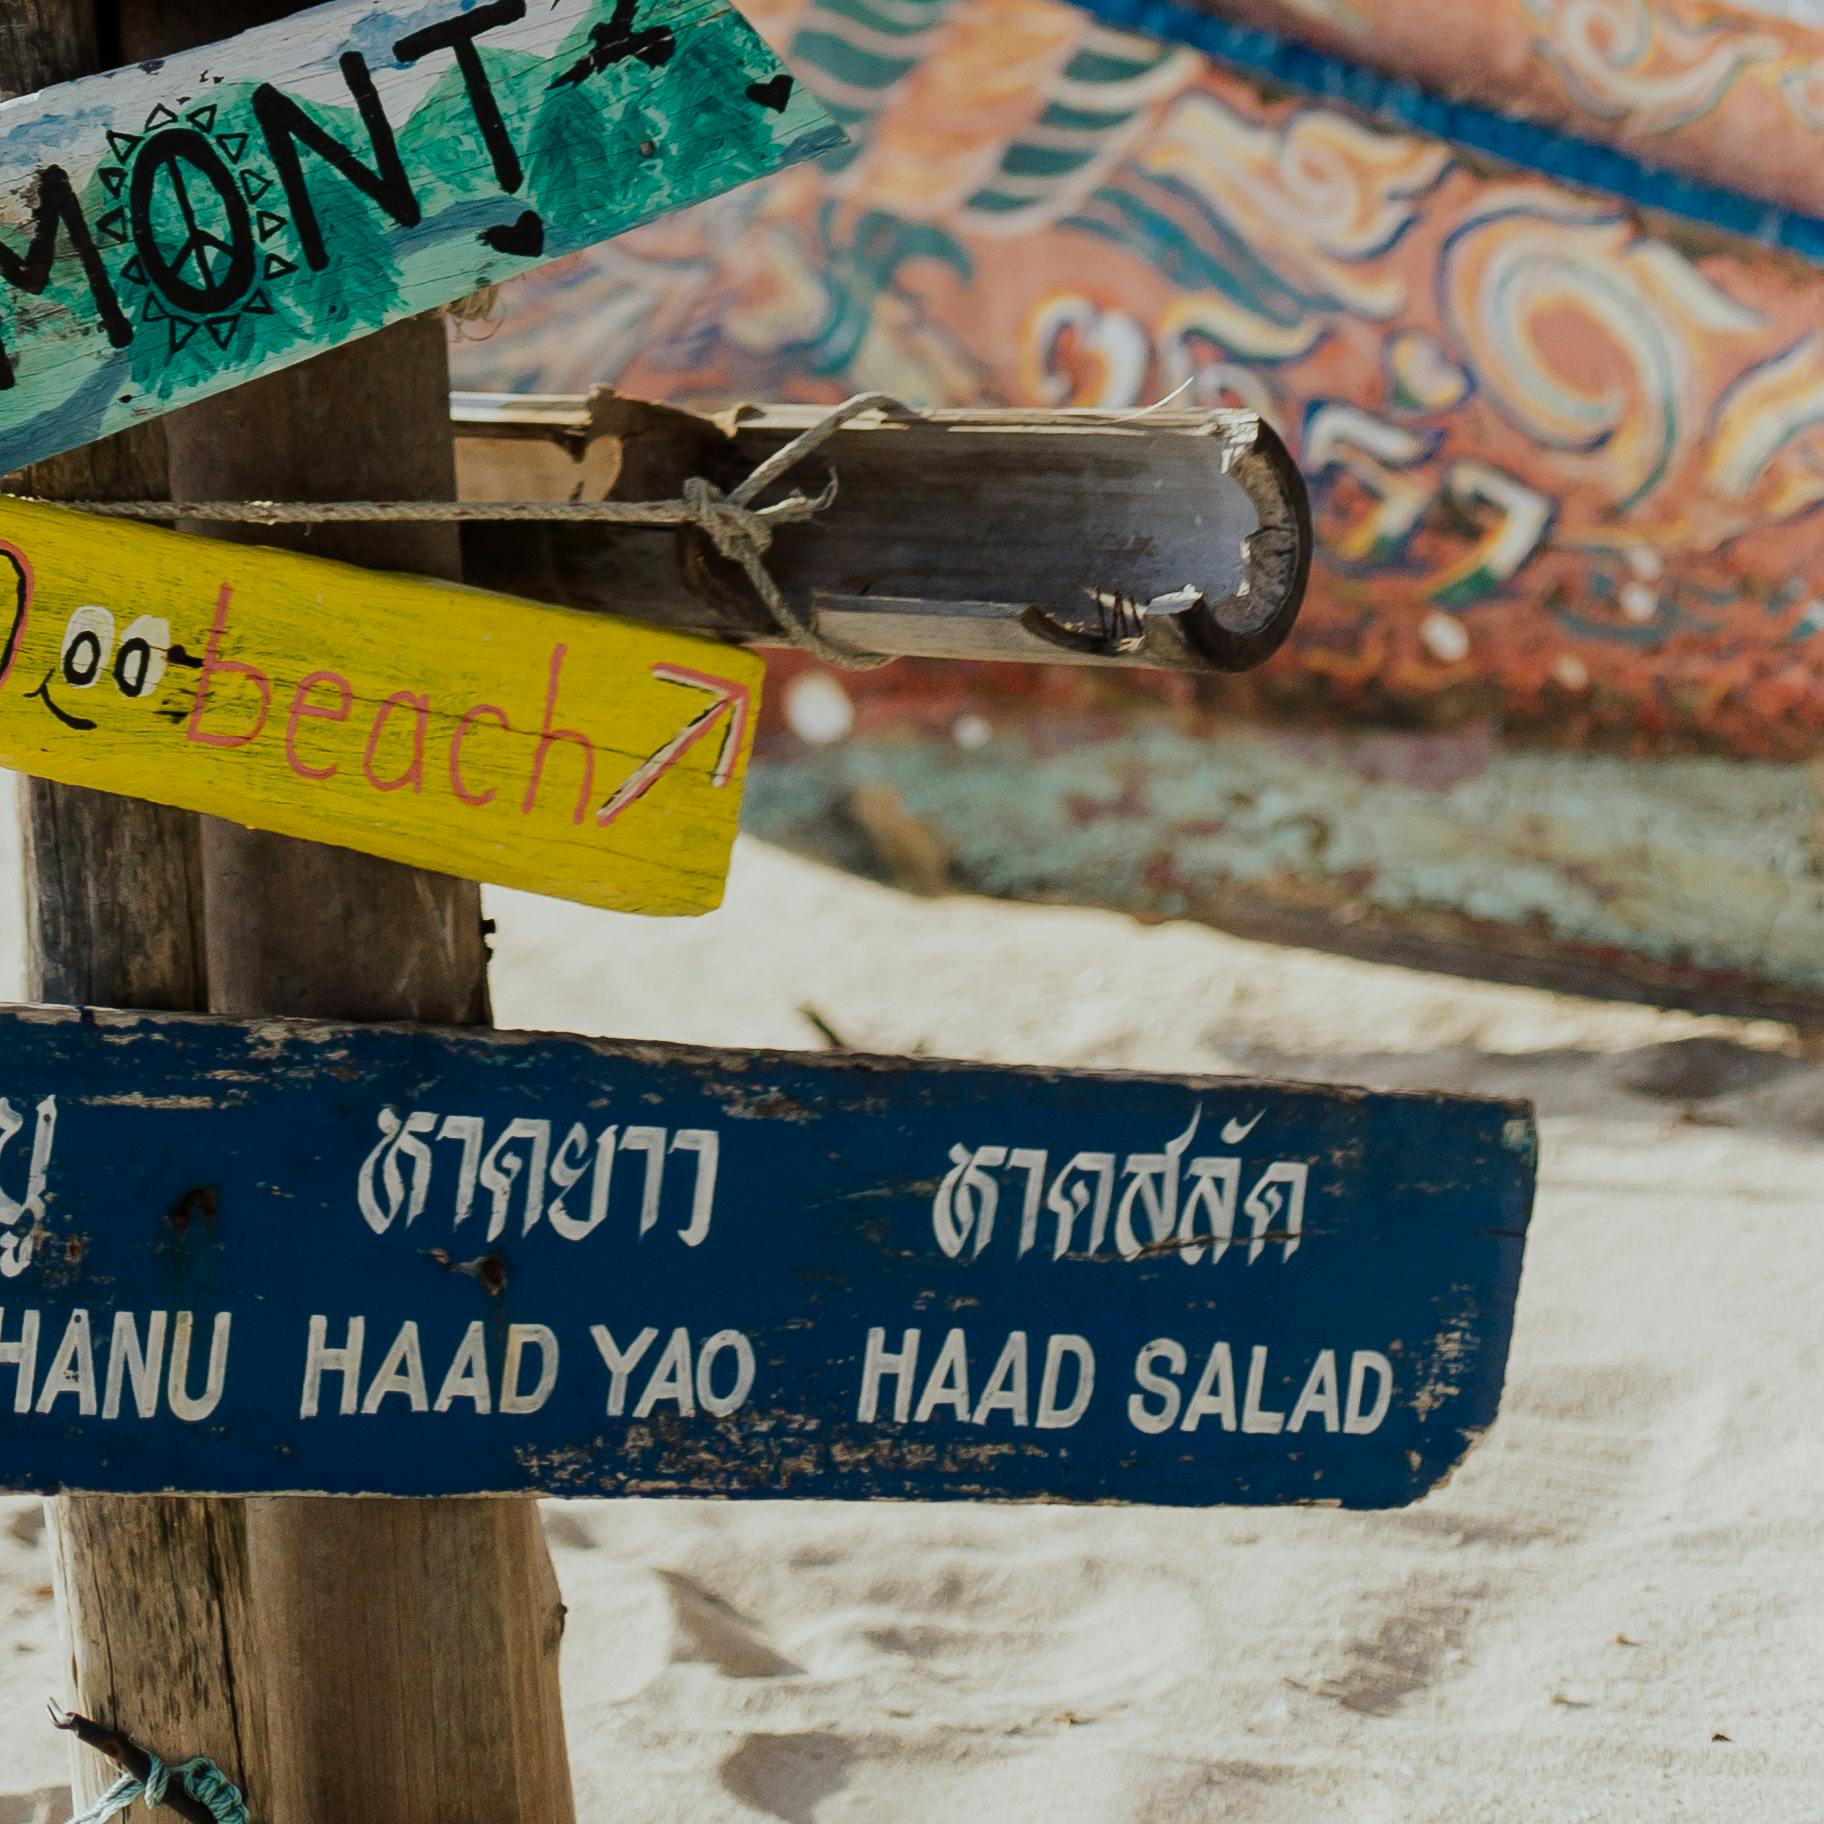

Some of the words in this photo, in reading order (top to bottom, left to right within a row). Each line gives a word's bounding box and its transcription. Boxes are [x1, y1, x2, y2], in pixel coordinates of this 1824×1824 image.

[186, 582, 595, 825] beach
[357, 1105, 719, 1248] หาดยาว
[298, 1314, 560, 1418] HAAD
[590, 1324, 756, 1419] YAO
[857, 1326, 1096, 1429] HAAD
[1127, 1337, 1394, 1435] SALAD
